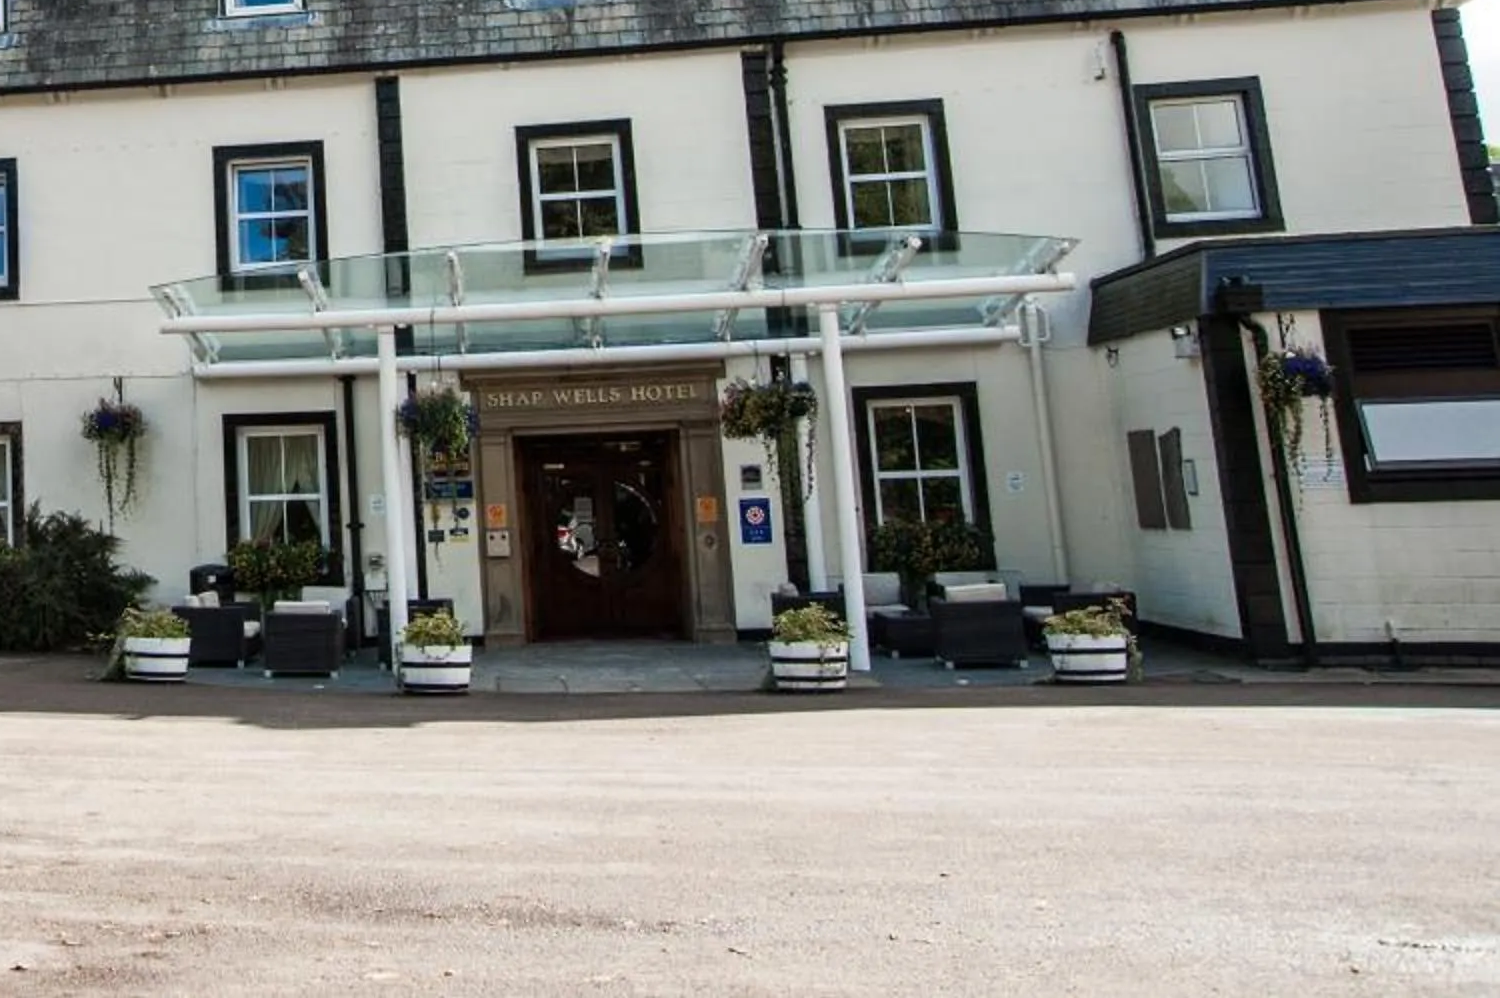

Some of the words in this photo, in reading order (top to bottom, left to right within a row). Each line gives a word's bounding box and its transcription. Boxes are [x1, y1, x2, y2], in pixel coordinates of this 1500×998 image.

[487, 391, 542, 407] SHAP
[553, 387, 621, 404] WELLS
[631, 384, 697, 401] HOTEL
